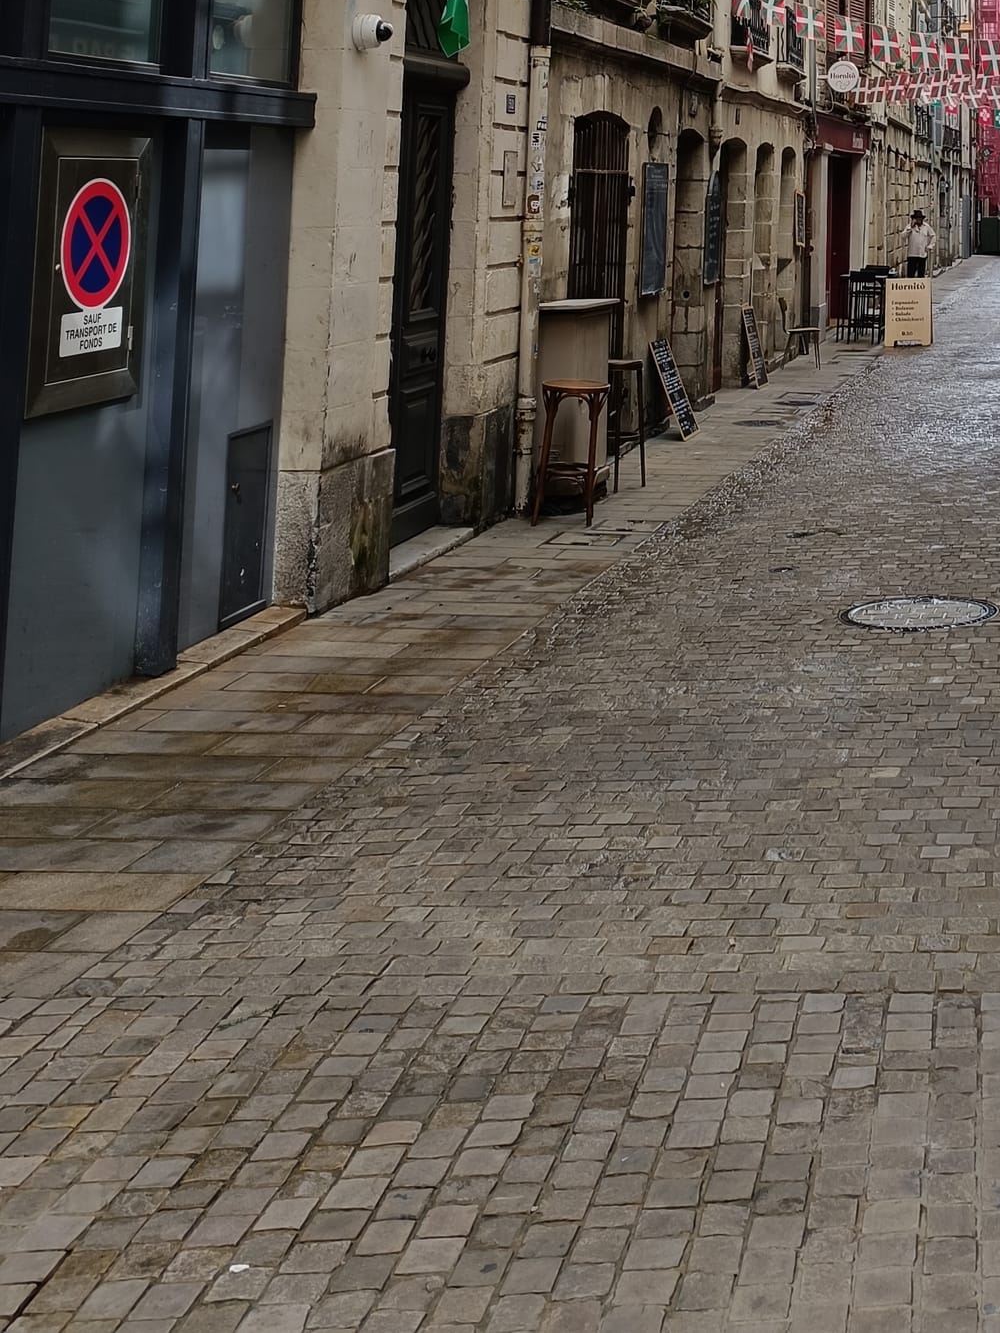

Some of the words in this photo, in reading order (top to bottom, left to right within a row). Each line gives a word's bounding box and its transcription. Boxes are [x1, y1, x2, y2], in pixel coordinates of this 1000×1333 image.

[83, 313, 102, 325] SAUF
[65, 324, 107, 340] TRANSPORT
[108, 323, 117, 333] DE
[79, 337, 103, 350] FONDS
